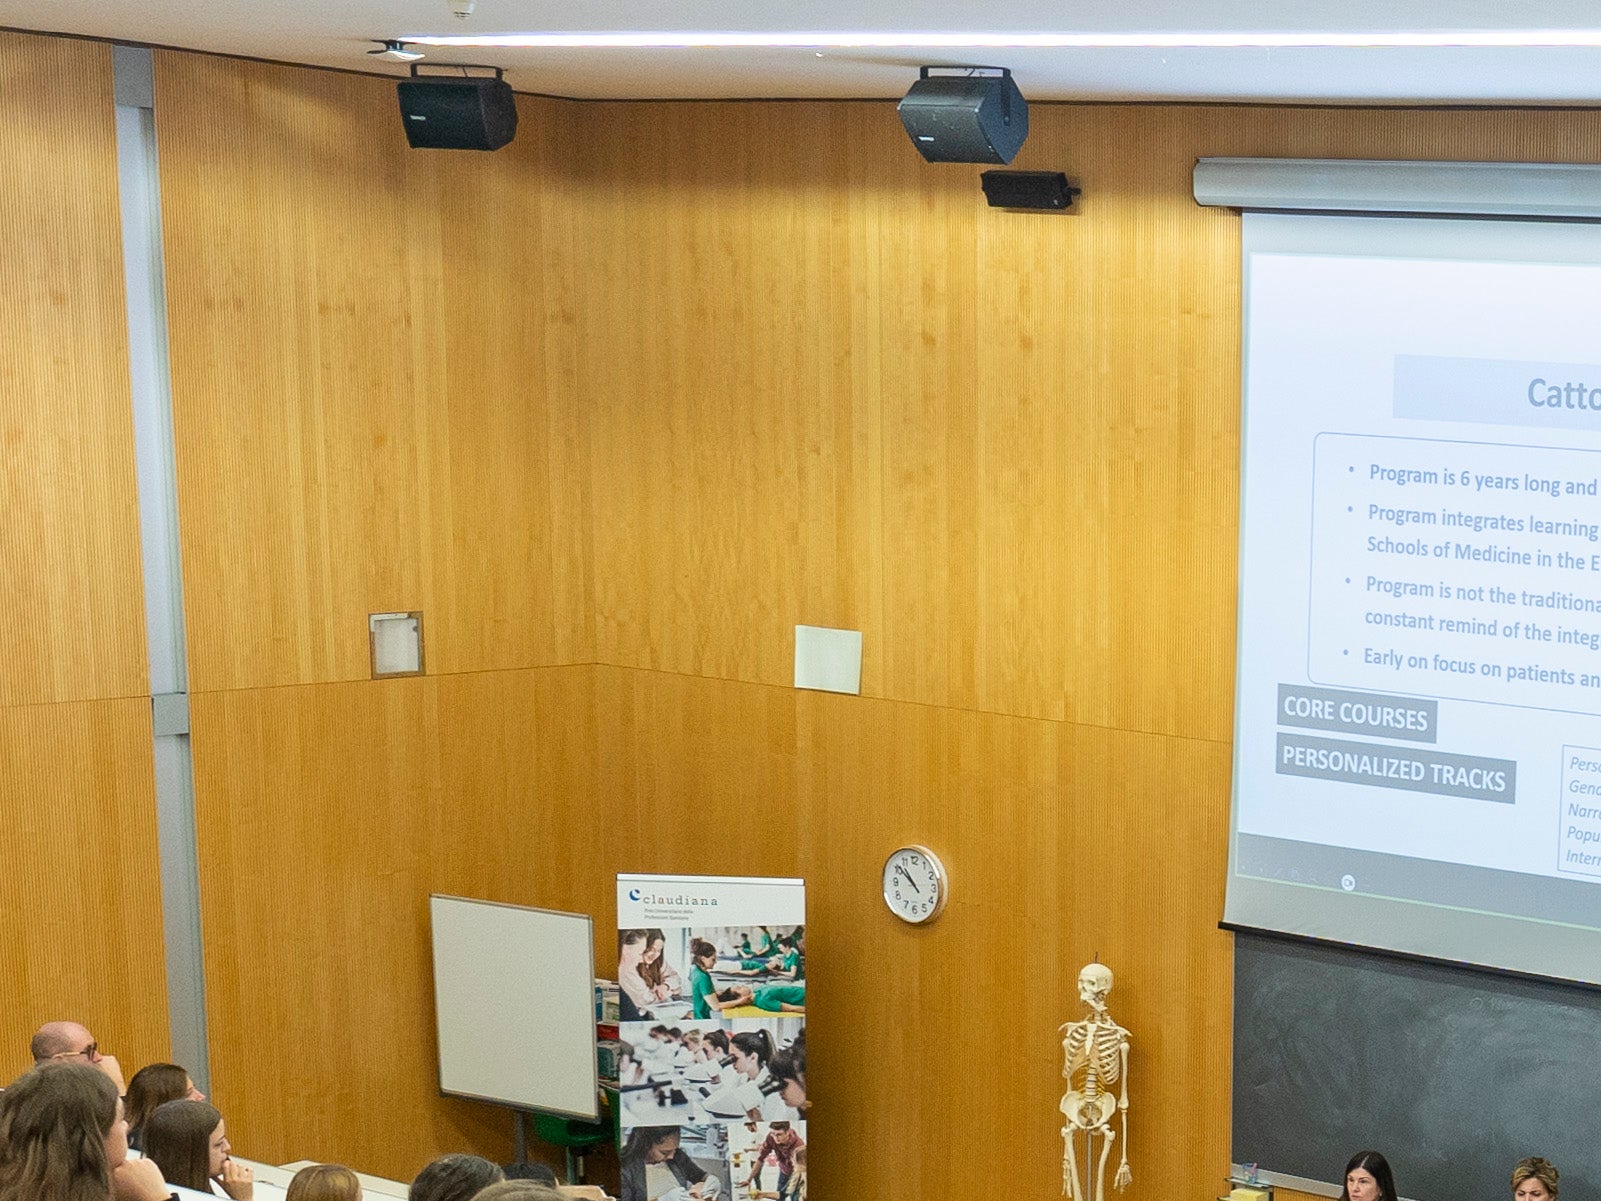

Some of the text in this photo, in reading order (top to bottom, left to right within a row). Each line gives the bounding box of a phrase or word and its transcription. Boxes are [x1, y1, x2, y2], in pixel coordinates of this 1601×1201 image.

[1369, 463, 1437, 485] Program
[1443, 467, 1455, 485] is
[1460, 470, 1469, 486] 6
[1474, 474, 1518, 491] years
[1524, 473, 1560, 497] long
[1565, 478, 1597, 495] and
[1368, 503, 1436, 525] Program
[1441, 508, 1524, 532] integrates
[1529, 515, 1598, 541] learning
[1367, 535, 1428, 556] Schools
[1433, 541, 1450, 557] of
[1454, 543, 1531, 565] Medicine
[1537, 548, 1551, 567] in
[1556, 551, 1585, 569] the
[1366, 575, 1433, 597] Program
[1439, 581, 1451, 598] is
[1456, 586, 1484, 601] not
[1488, 586, 1515, 604] the
[1365, 612, 1434, 630] constant
[1439, 617, 1497, 636] remind
[1502, 621, 1520, 638] of
[1523, 623, 1551, 641] the
[1364, 647, 1403, 670] Early
[1407, 656, 1427, 669] on
[1432, 654, 1475, 674] focus
[1480, 663, 1501, 677] on
[1506, 664, 1574, 685] patients
[1284, 696, 1428, 732] CORE COURSES
[1284, 745, 1505, 792] PERSONALIZED TRACKS
[643, 894, 718, 906] claudiana
